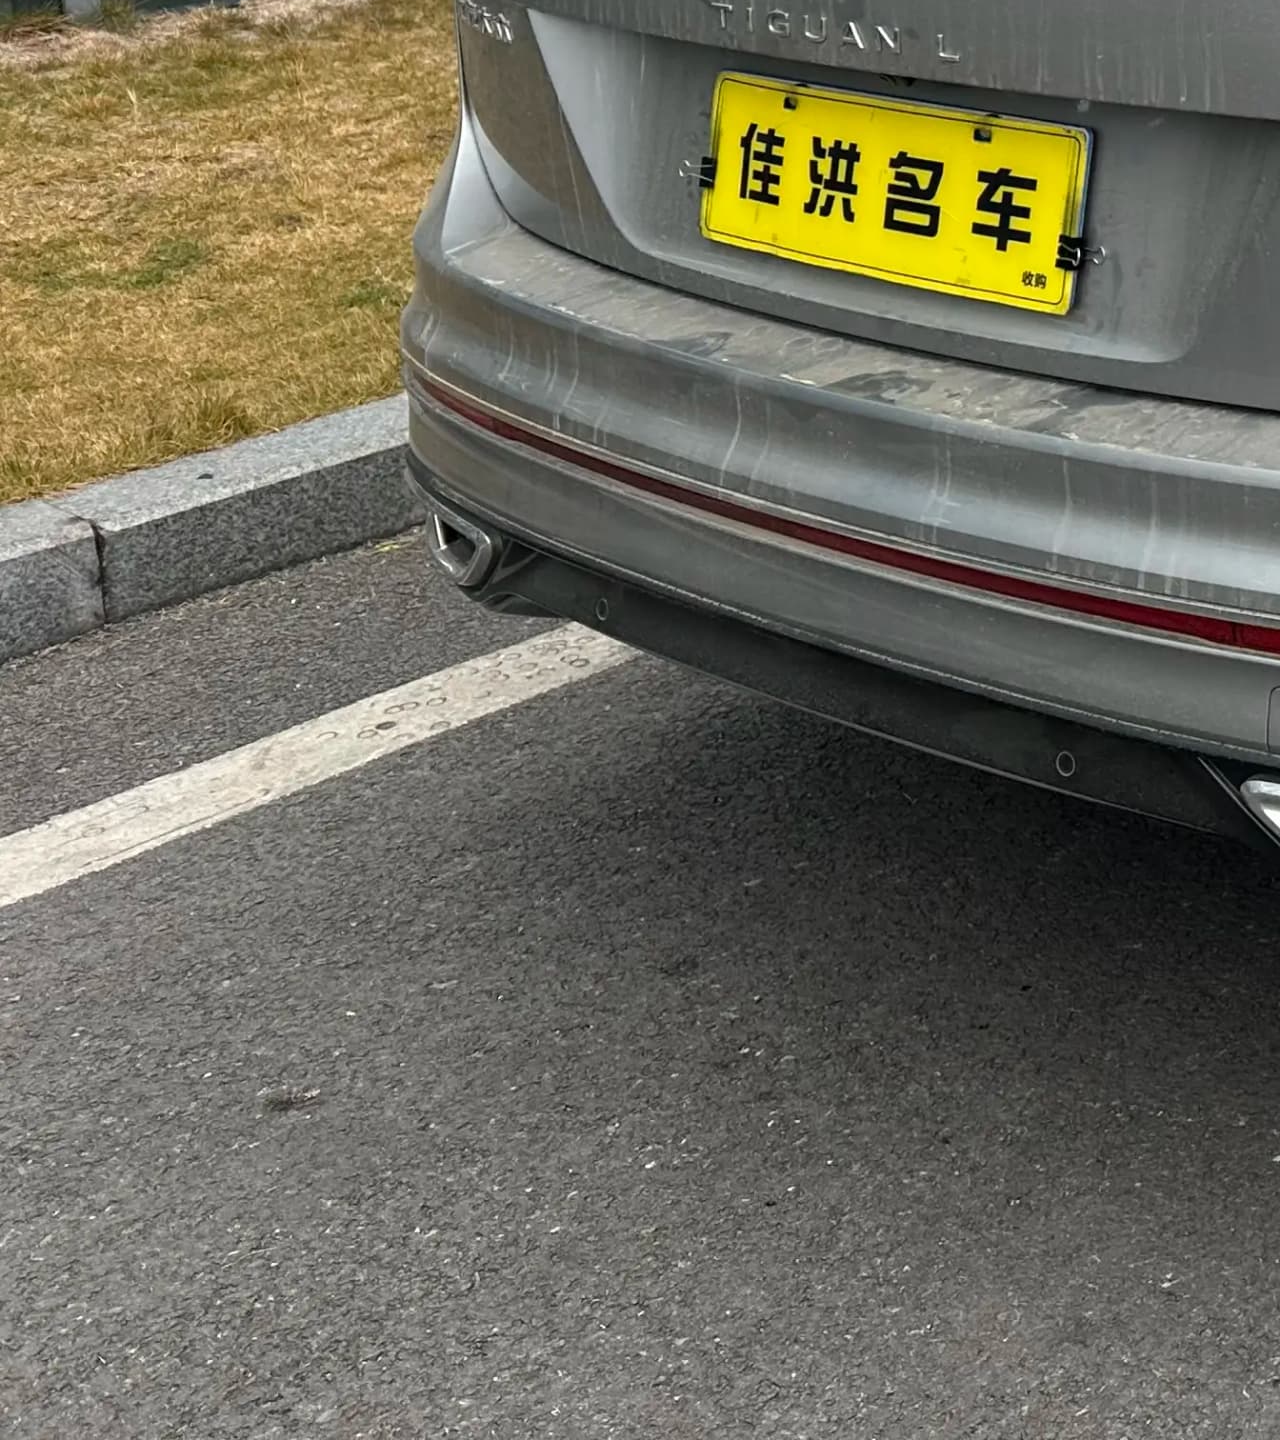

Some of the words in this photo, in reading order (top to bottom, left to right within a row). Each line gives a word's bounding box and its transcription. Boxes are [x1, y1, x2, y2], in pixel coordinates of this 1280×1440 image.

[710, 1, 900, 56] TIGUAN
[936, 32, 961, 62] L
[739, 122, 1037, 252] 佳洪名车
[1021, 269, 1047, 290] 收购
